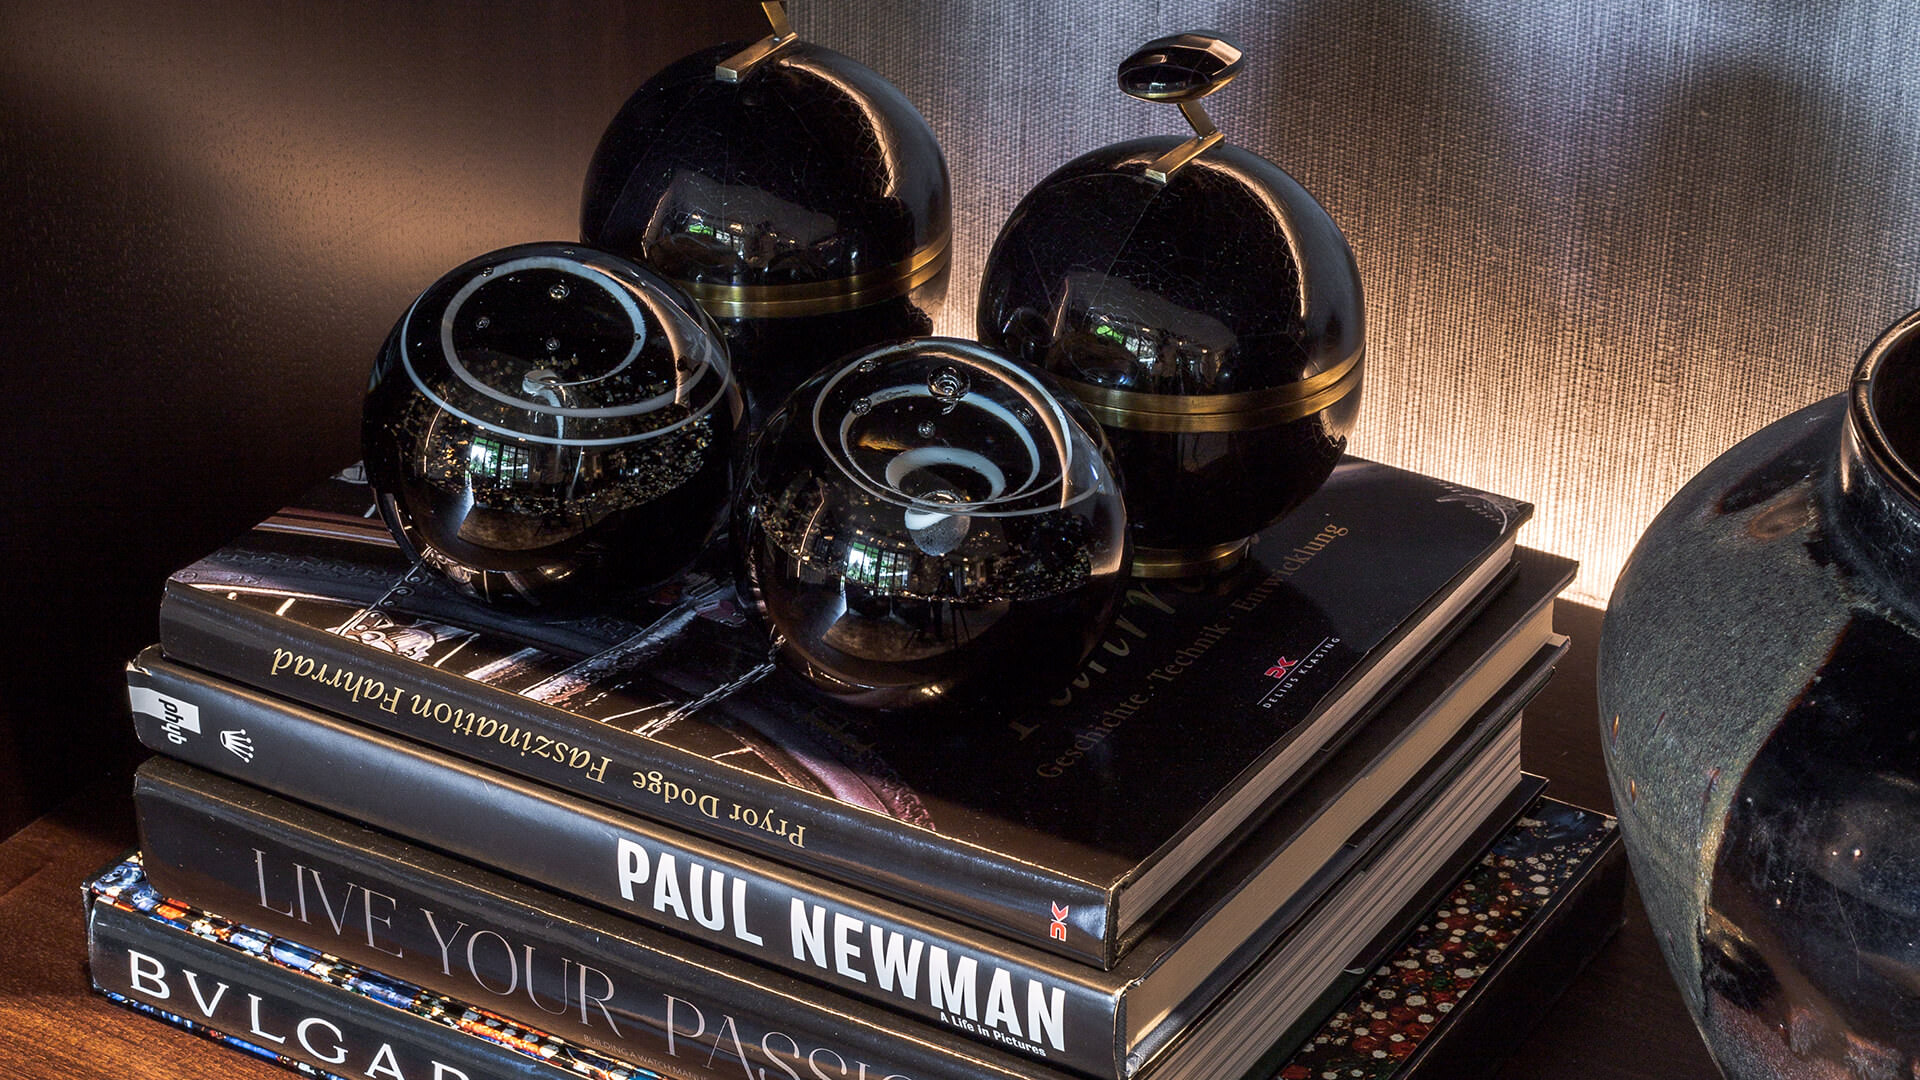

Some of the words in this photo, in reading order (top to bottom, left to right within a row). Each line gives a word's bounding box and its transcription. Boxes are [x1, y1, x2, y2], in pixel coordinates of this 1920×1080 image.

[271, 647, 404, 714] Fahrrad
[1036, 693, 1149, 778] Geschichte
[1150, 621, 1232, 683] Technik
[1233, 522, 1349, 613] Entwicklung
[1262, 677, 1299, 709] DELIUS
[1298, 637, 1341, 675] KLASING
[158, 698, 188, 745] phyb
[411, 694, 613, 784] Faszination
[632, 770, 721, 819] Dodge
[730, 801, 806, 849] Pryor
[250, 847, 404, 959] LIVE
[420, 907, 624, 1039] YOUR
[663, 993, 913, 1080] PASS
[616, 837, 764, 947] PAUL
[790, 897, 1066, 1053] NEWMAN
[583, 1034, 629, 1057] BUILDING
[639, 1055, 673, 1073] WATCH
[940, 1011, 950, 1024] A
[951, 1015, 975, 1033] Life
[977, 1023, 991, 1038] in
[992, 1030, 1047, 1057] Pictures
